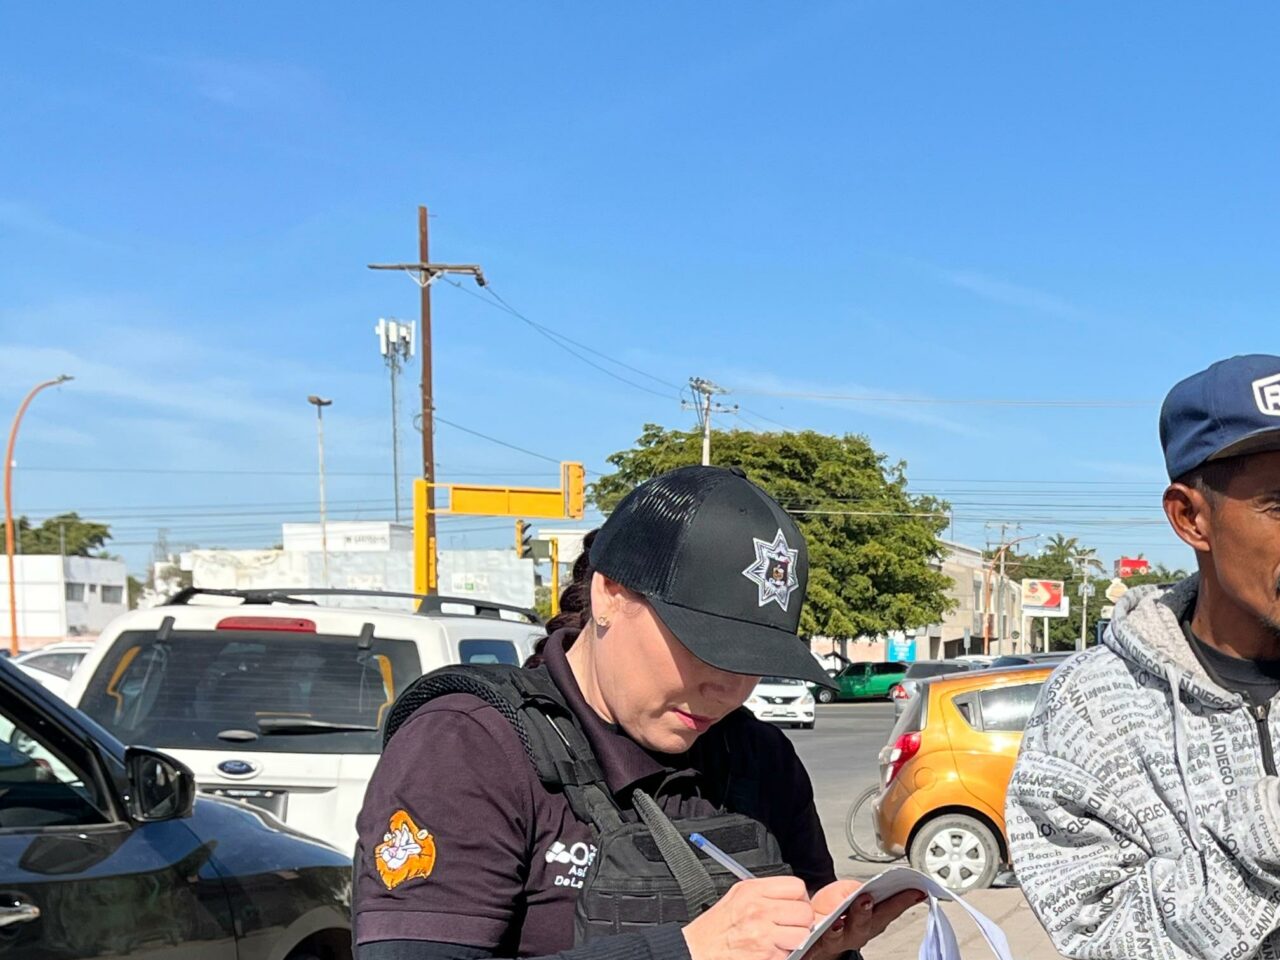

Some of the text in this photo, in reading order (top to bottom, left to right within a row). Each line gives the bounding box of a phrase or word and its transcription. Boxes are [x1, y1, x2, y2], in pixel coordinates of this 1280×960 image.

[1131, 645, 1161, 676] DIEGO
[1083, 684, 1111, 701] Laguna
[1192, 683, 1233, 710] DIEGO
[1099, 702, 1131, 718] Baker
[1208, 716, 1224, 742] SAN
[1213, 743, 1235, 786] DIEGO
[1010, 830, 1035, 843] Beach
[1248, 822, 1267, 858] Beach
[1028, 849, 1063, 861] Beach
[1072, 844, 1111, 861] Beach
[554, 875, 570, 887] De
[568, 864, 588, 878] Así
[1052, 898, 1076, 917] Santa
[1196, 921, 1221, 948] Baker
[1250, 914, 1272, 941] SAN
[1125, 930, 1137, 957] DIEGO
